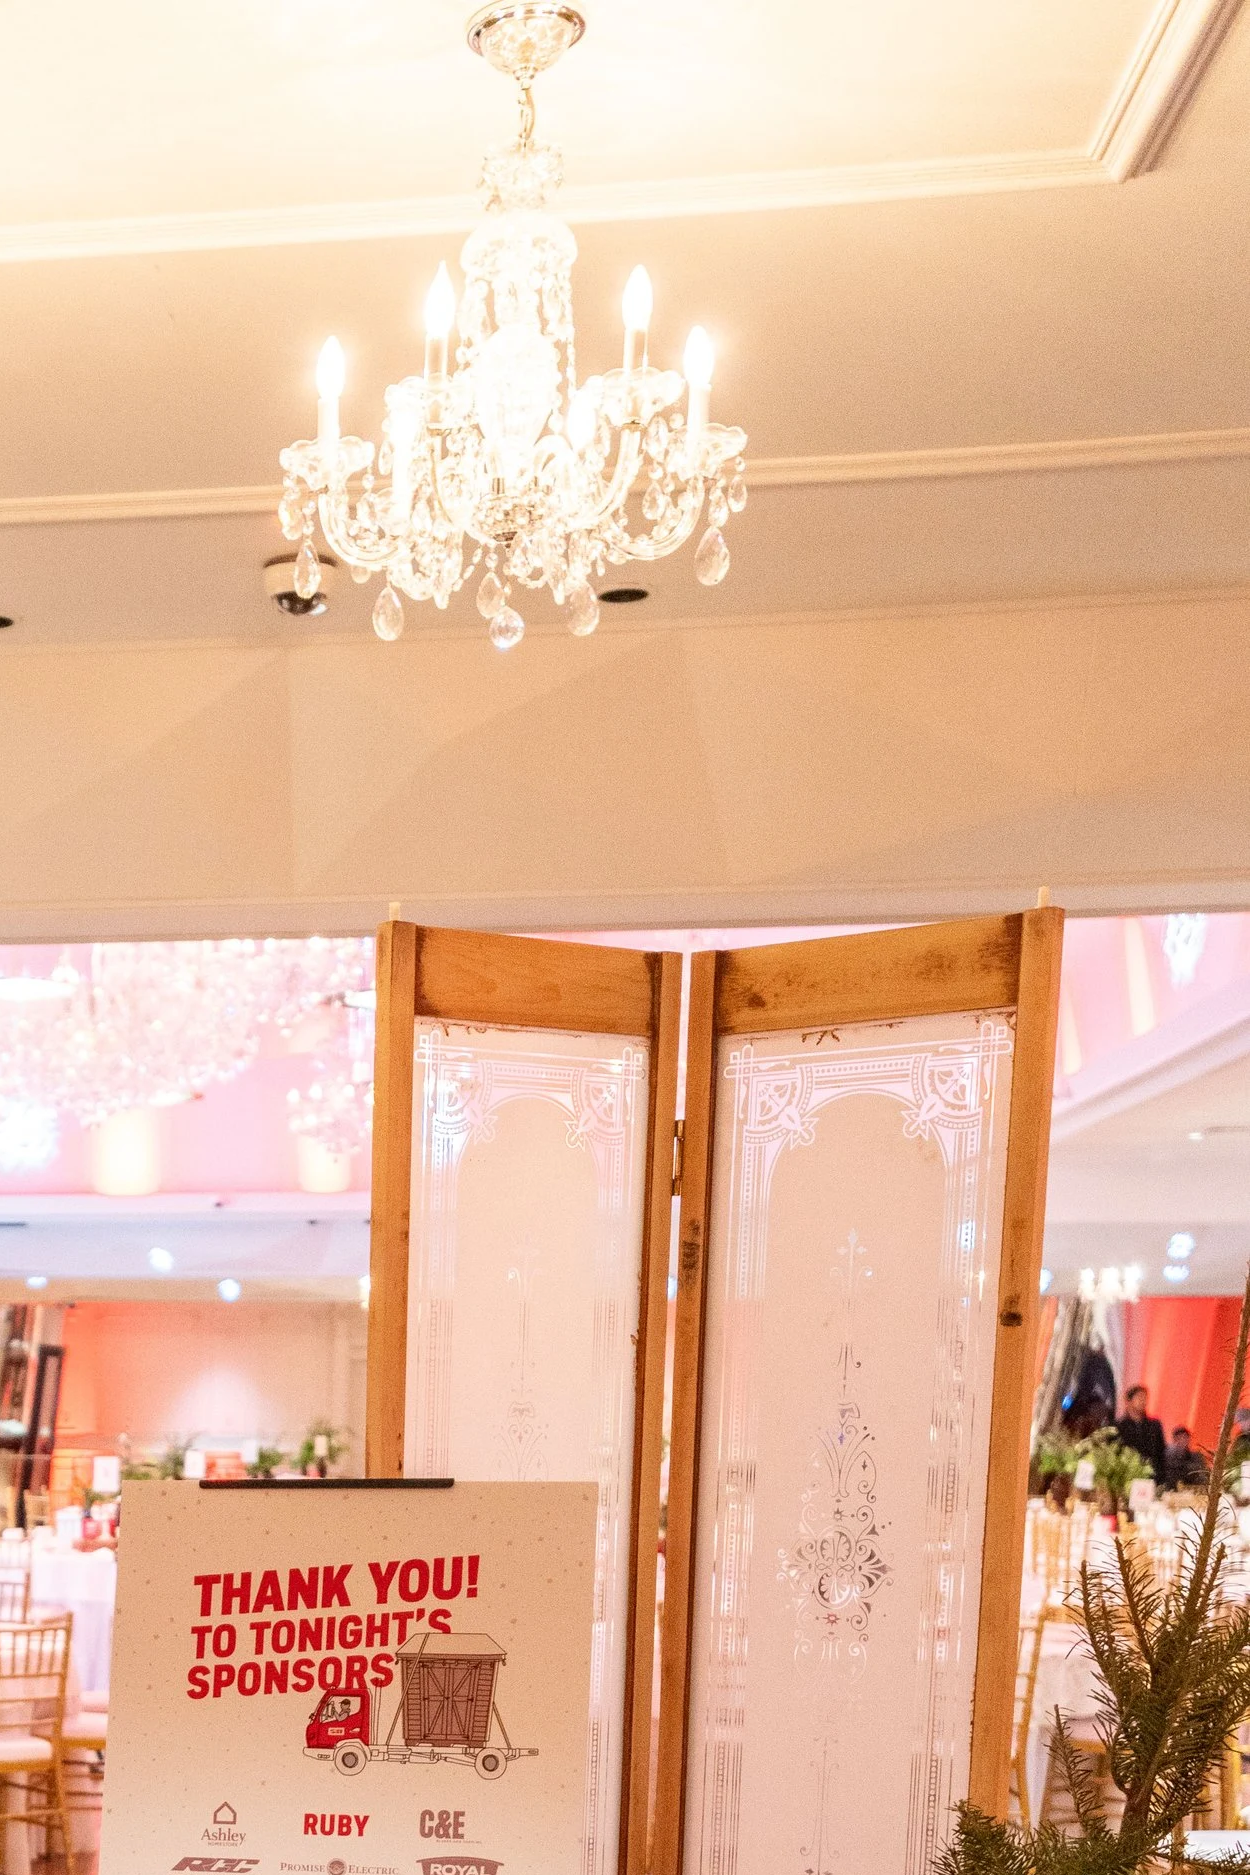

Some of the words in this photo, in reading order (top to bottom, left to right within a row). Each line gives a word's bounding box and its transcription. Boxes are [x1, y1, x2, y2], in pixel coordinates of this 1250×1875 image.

[193, 1564, 353, 1617] THANK
[368, 1554, 481, 1605] YOU!
[191, 1623, 237, 1660] TO
[250, 1608, 452, 1656] TONIGHT'S
[186, 1653, 395, 1699] SPONSORS
[201, 1827, 246, 1845] Ashley
[303, 1813, 370, 1837] RUBY
[419, 1809, 465, 1840] C&E
[280, 1862, 326, 1873] PROMISE
